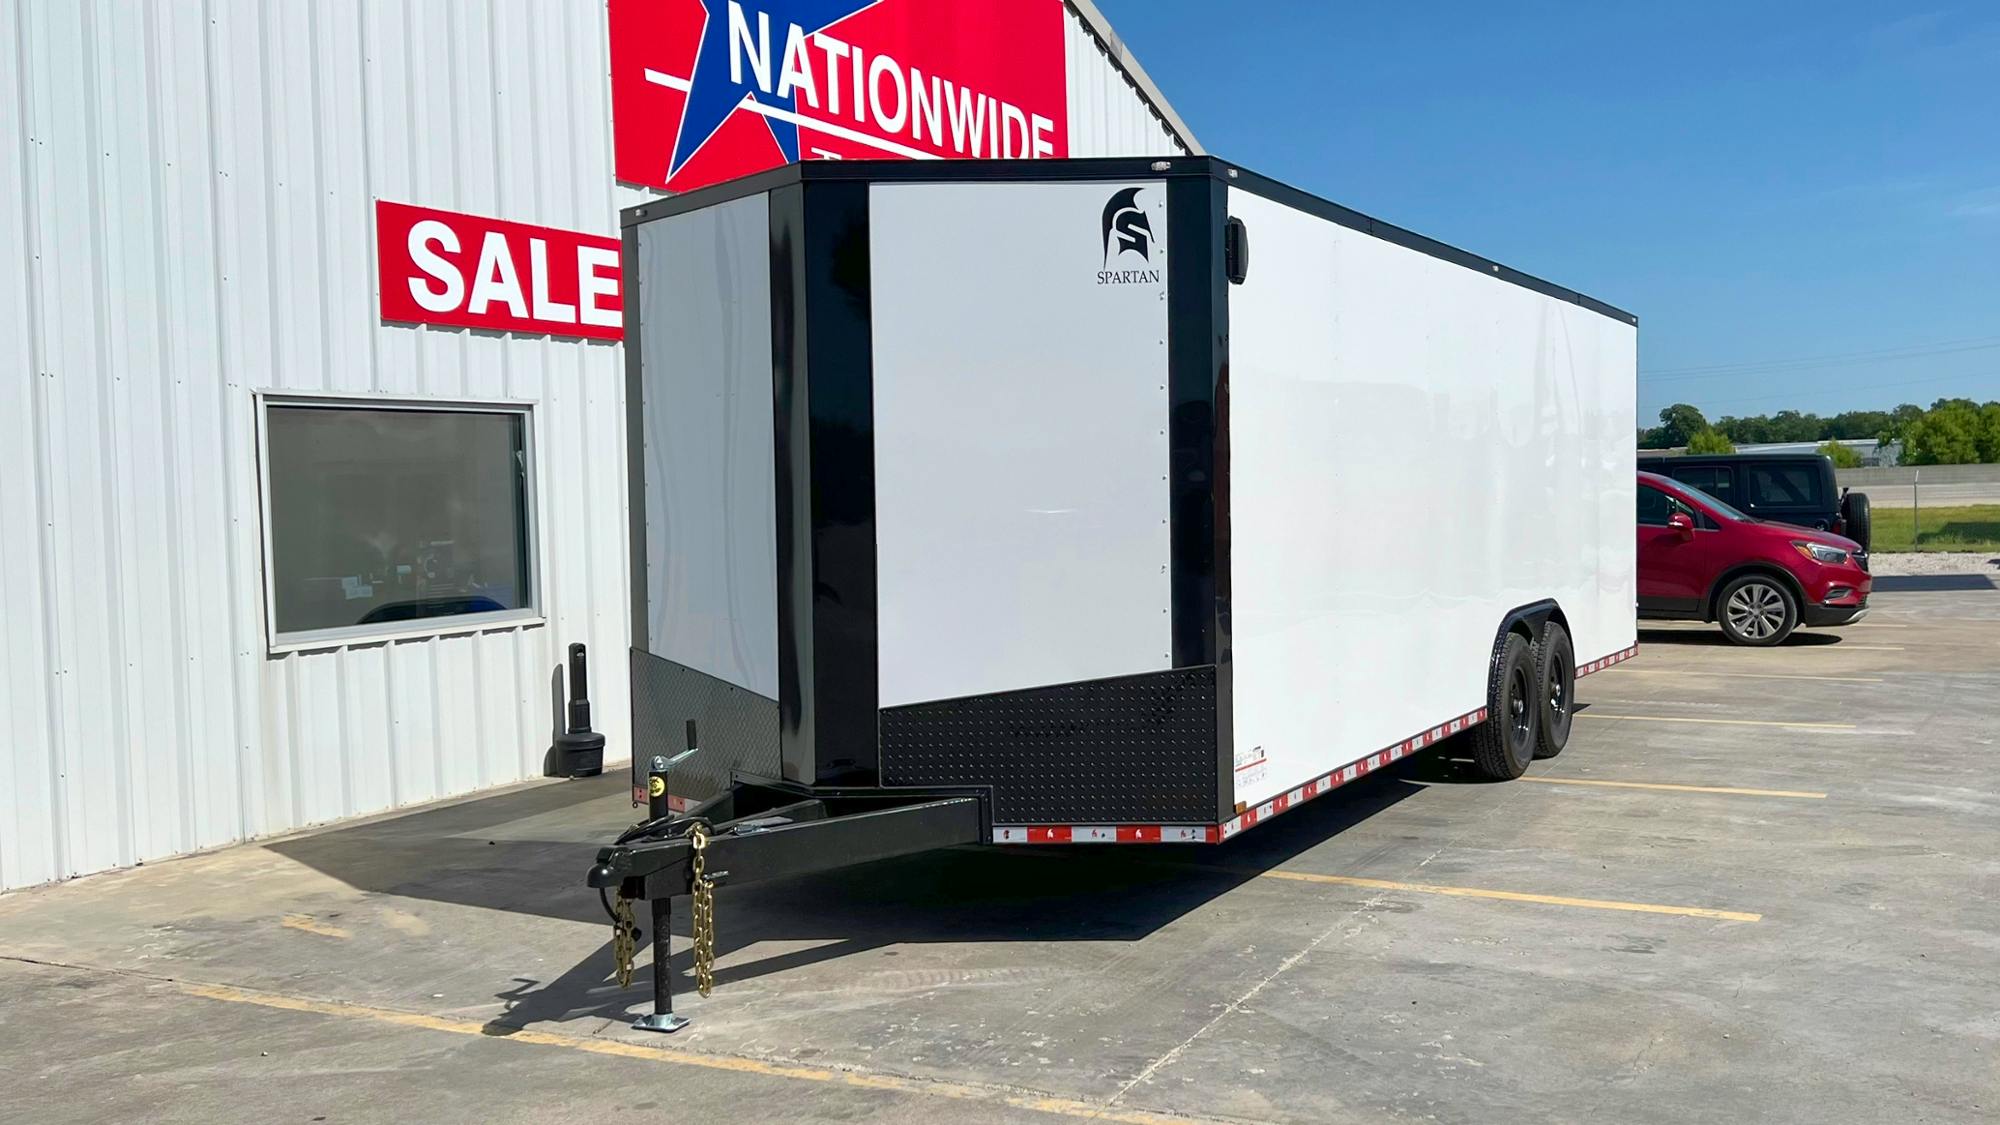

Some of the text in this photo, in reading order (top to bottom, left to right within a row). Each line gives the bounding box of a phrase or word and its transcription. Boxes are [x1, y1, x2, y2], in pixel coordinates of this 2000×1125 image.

[728, 0, 1054, 159] NATIONWIDE
[407, 220, 622, 328] SALE
[1097, 269, 1160, 285] SPARTAN
